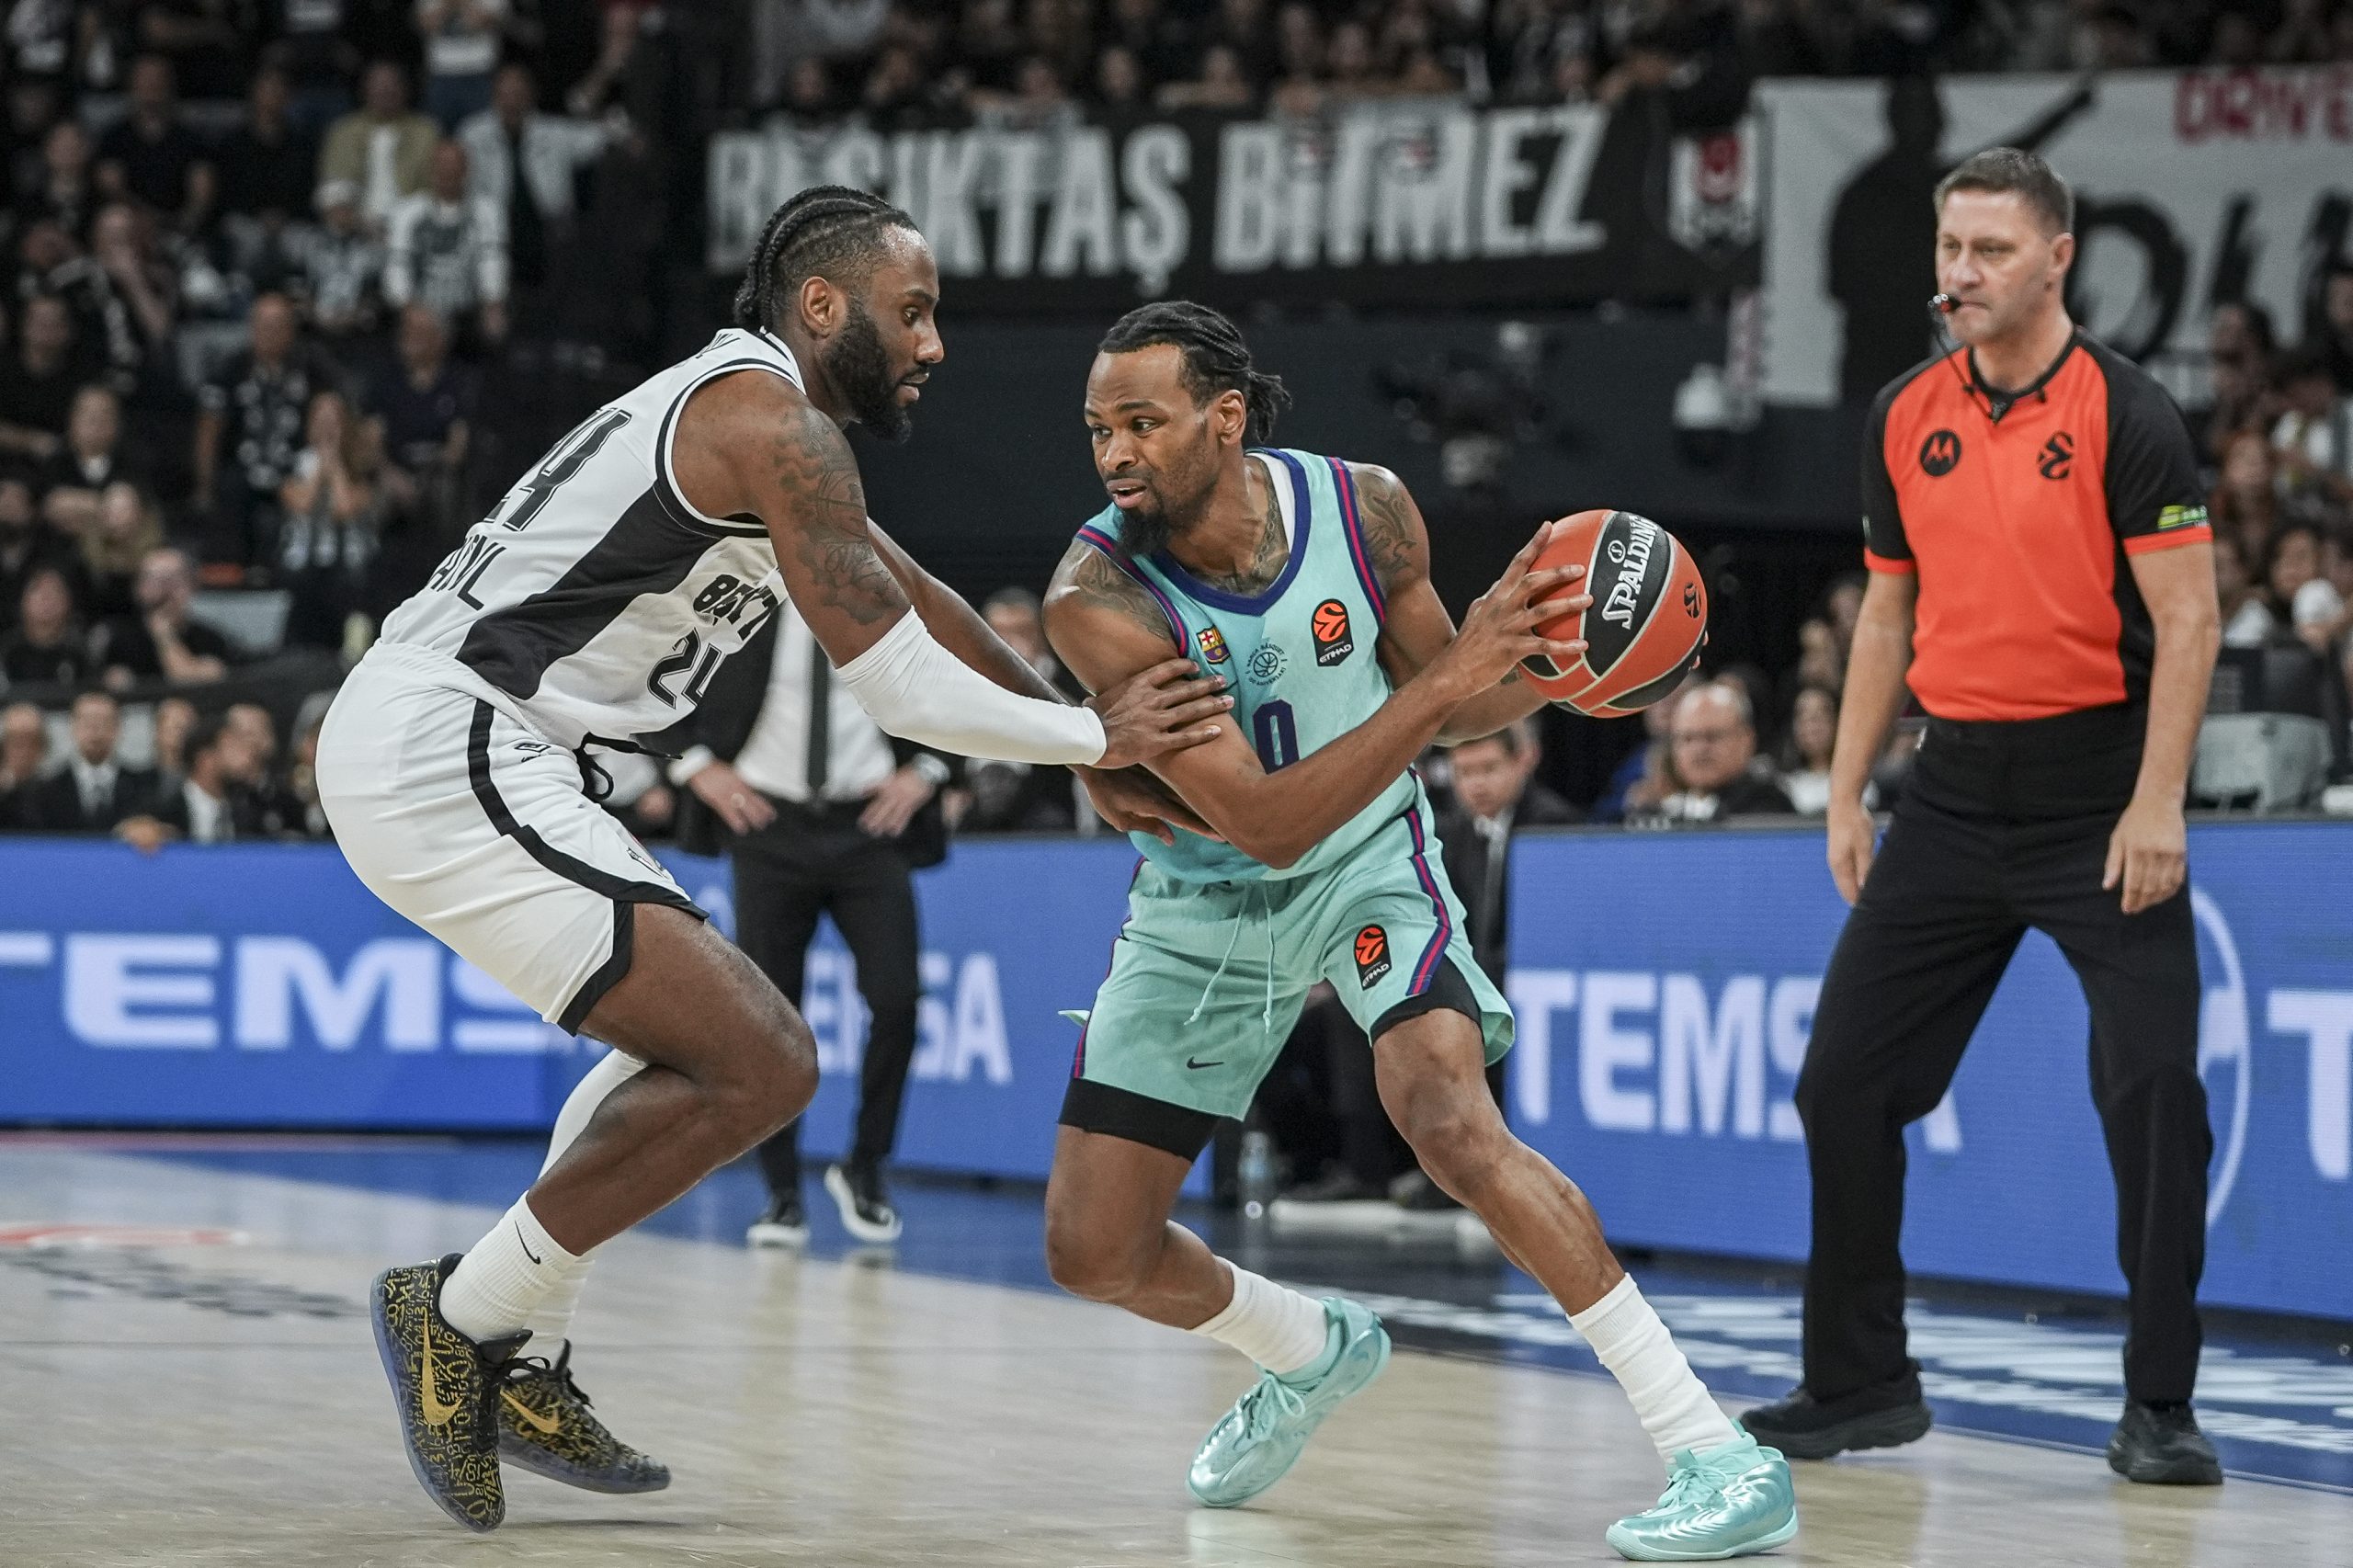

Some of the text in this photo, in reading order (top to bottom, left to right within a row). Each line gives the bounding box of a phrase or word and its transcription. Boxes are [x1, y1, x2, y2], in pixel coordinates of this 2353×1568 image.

[484, 406, 632, 532] 4
[1602, 515, 1658, 631] SPALDING
[1319, 643, 1352, 664] ETIHAD
[1253, 699, 1300, 775] 0
[1506, 970, 1962, 1153] TEMS
